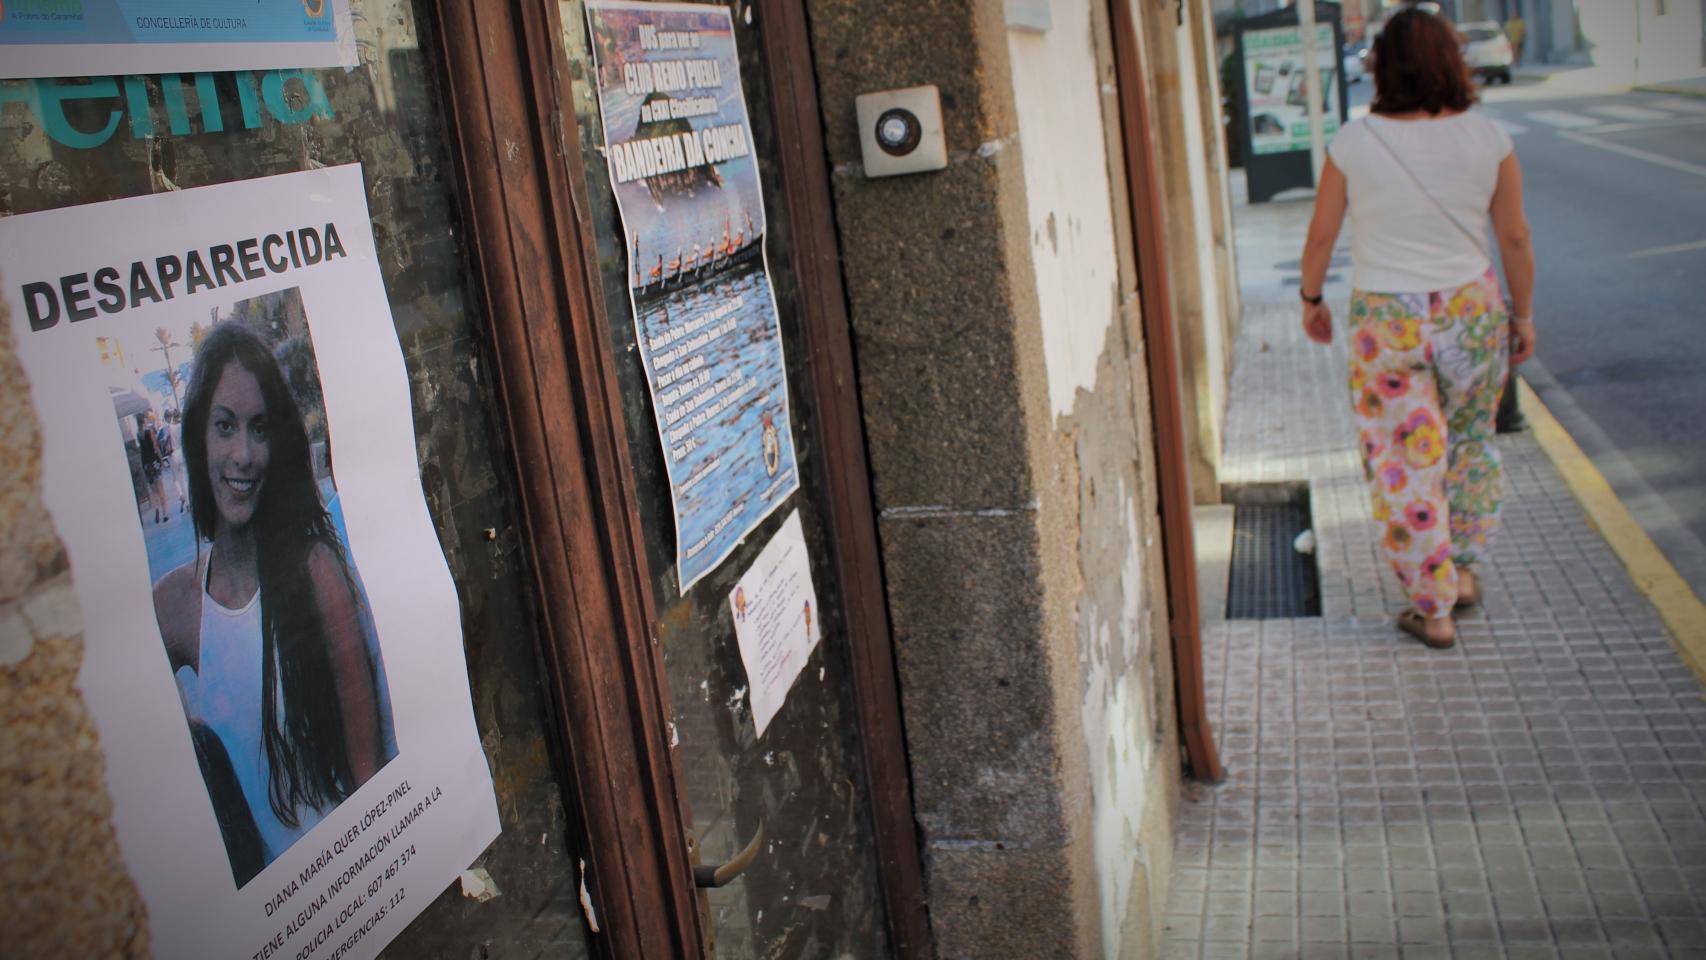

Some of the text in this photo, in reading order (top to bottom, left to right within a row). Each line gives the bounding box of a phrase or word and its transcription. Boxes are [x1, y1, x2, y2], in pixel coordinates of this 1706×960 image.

[200, 18, 212, 29] DE
[212, 18, 247, 29] CULTURA
[624, 62, 653, 96] CLUB
[652, 61, 686, 92] REMO
[612, 123, 749, 183] BANDEIRA DA CONCHA
[22, 222, 347, 332] DESAPARECIDA
[253, 786, 442, 960] TIENE ALGUNA INFORMACIÓN LLAMAR A LA
[264, 780, 412, 917] DIANA MARÍA QUER LÓPEZ-PINEL
[296, 844, 416, 960] POLICIA LOCAL: 607 467 374
[390, 888, 406, 909] 112
